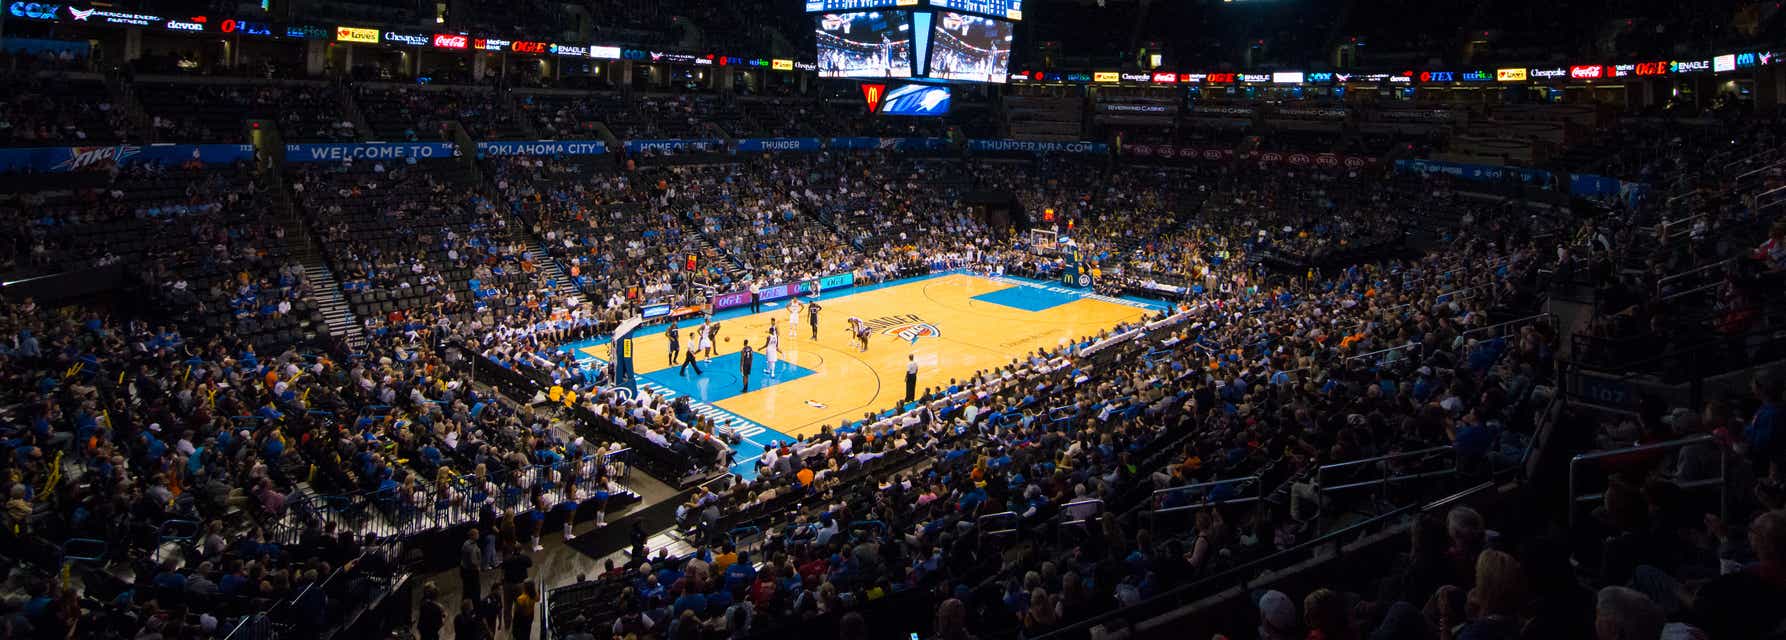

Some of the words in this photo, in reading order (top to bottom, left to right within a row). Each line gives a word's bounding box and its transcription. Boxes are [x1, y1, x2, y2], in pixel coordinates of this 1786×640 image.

[92, 10, 133, 19] AMERICAN
[107, 17, 149, 25] PARTNERS
[167, 21, 203, 30] devon
[1679, 61, 1709, 69] ENABLE
[489, 144, 563, 155] OKLAHOMA
[568, 143, 596, 154] CITY
[761, 141, 800, 149] THUNDER
[311, 146, 404, 159] WELCOME
[409, 146, 433, 157] TO
